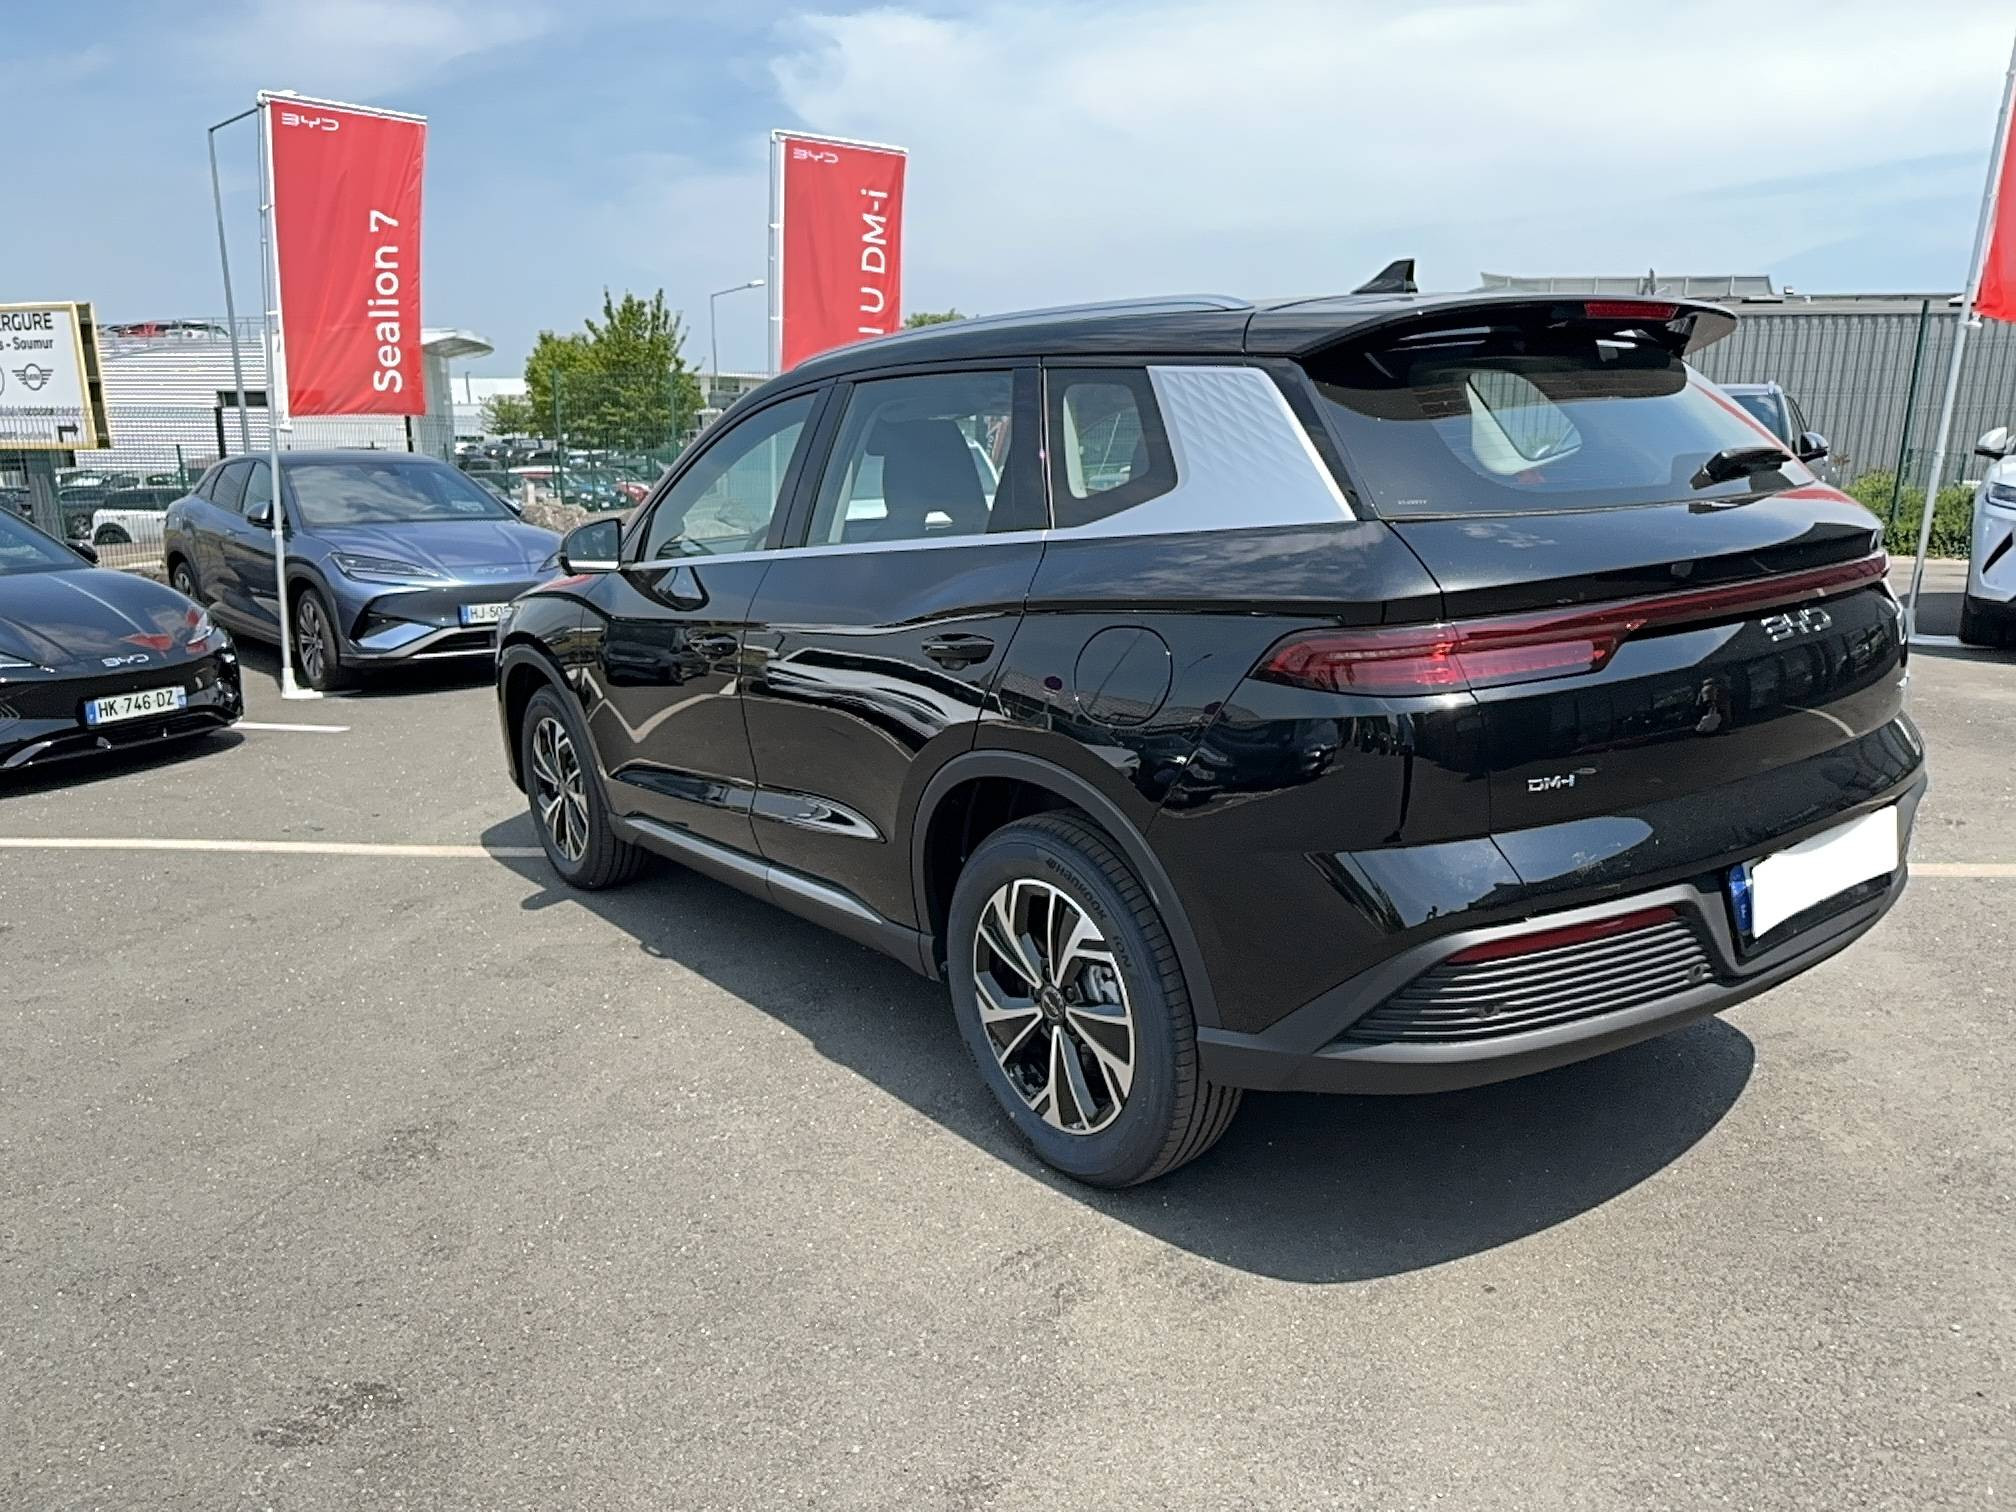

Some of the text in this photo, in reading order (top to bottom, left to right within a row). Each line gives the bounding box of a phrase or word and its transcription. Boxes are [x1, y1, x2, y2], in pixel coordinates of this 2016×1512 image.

[281, 112, 339, 131] BYD
[793, 148, 839, 163] BYD
[860, 188, 889, 274] DM-i
[368, 209, 402, 393] Sealion 7
[860, 286, 885, 313] U
[0, 313, 53, 331] RGURE
[12, 336, 53, 350] Saumur
[1761, 607, 1833, 642] BYD
[102, 654, 149, 667] BYD
